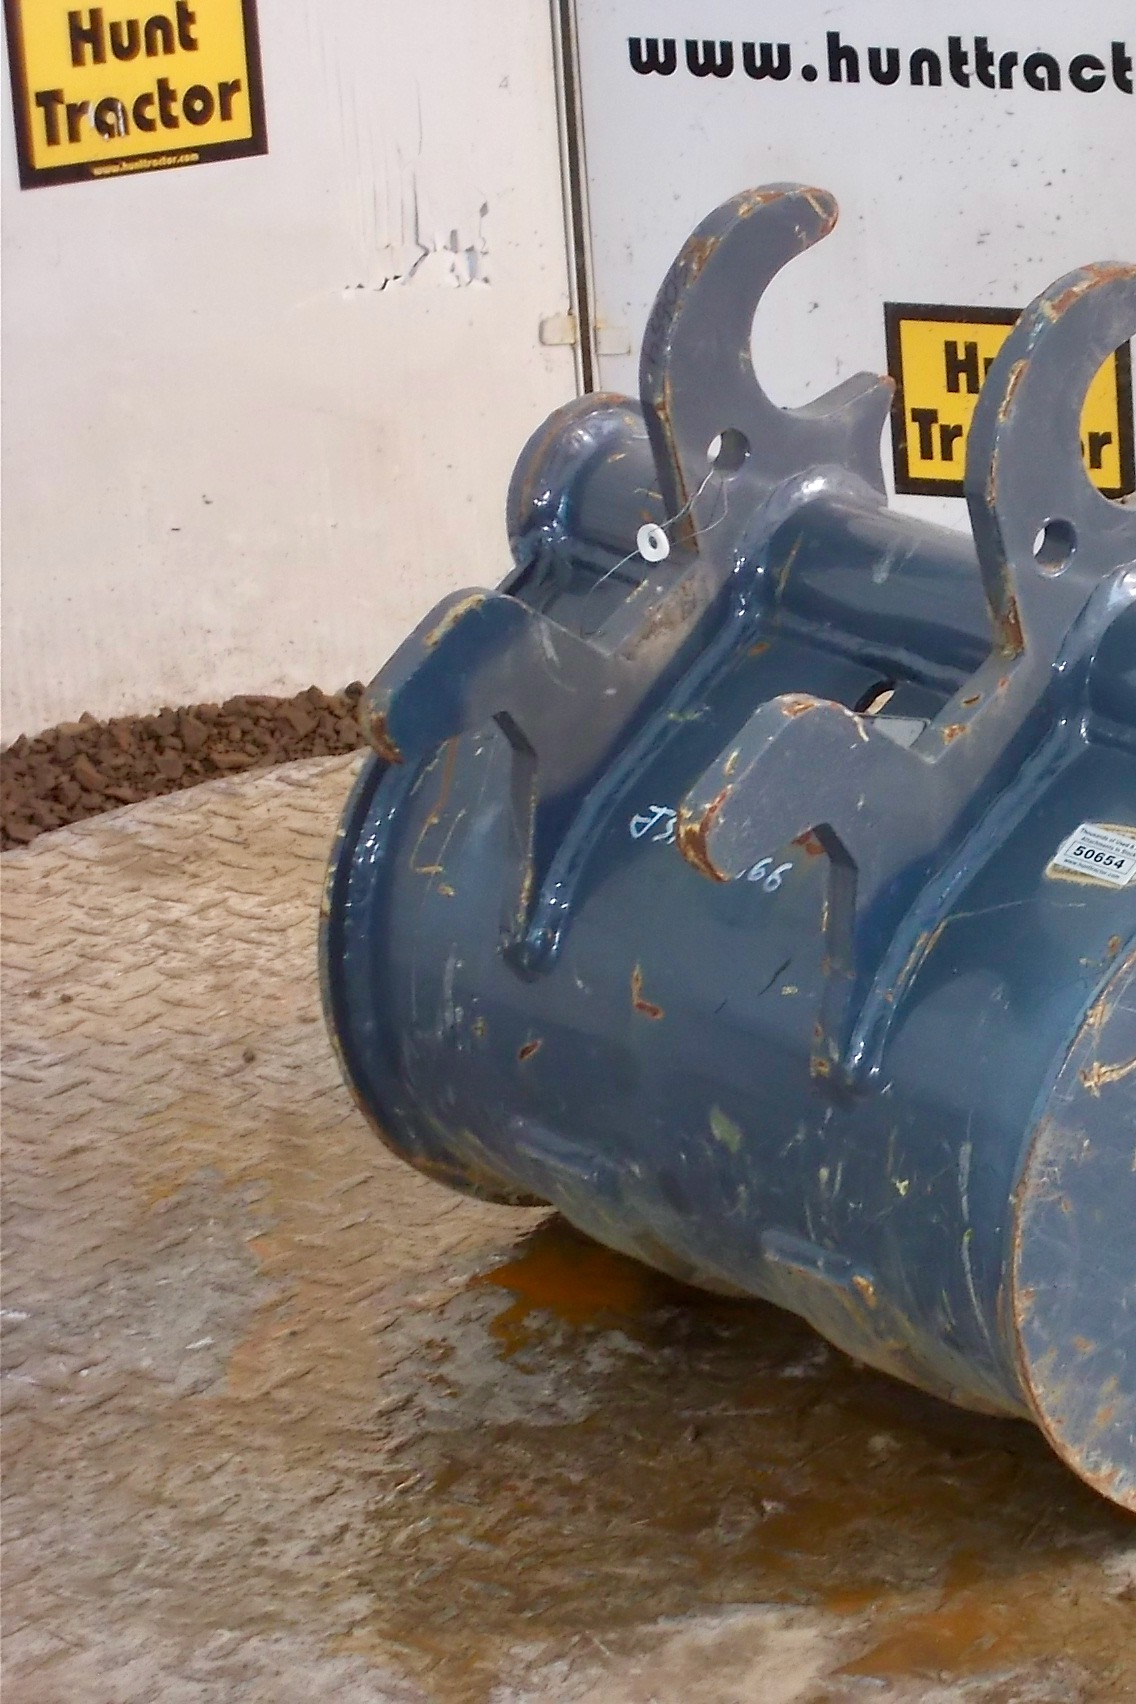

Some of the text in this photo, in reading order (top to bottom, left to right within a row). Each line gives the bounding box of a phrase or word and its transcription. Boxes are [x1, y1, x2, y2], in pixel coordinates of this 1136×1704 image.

[67, 1, 199, 68] Hunt
[35, 77, 242, 147] Tractor
[92, 152, 200, 176] www.hunttractor.com
[1073, 845, 1125, 869] 50654
